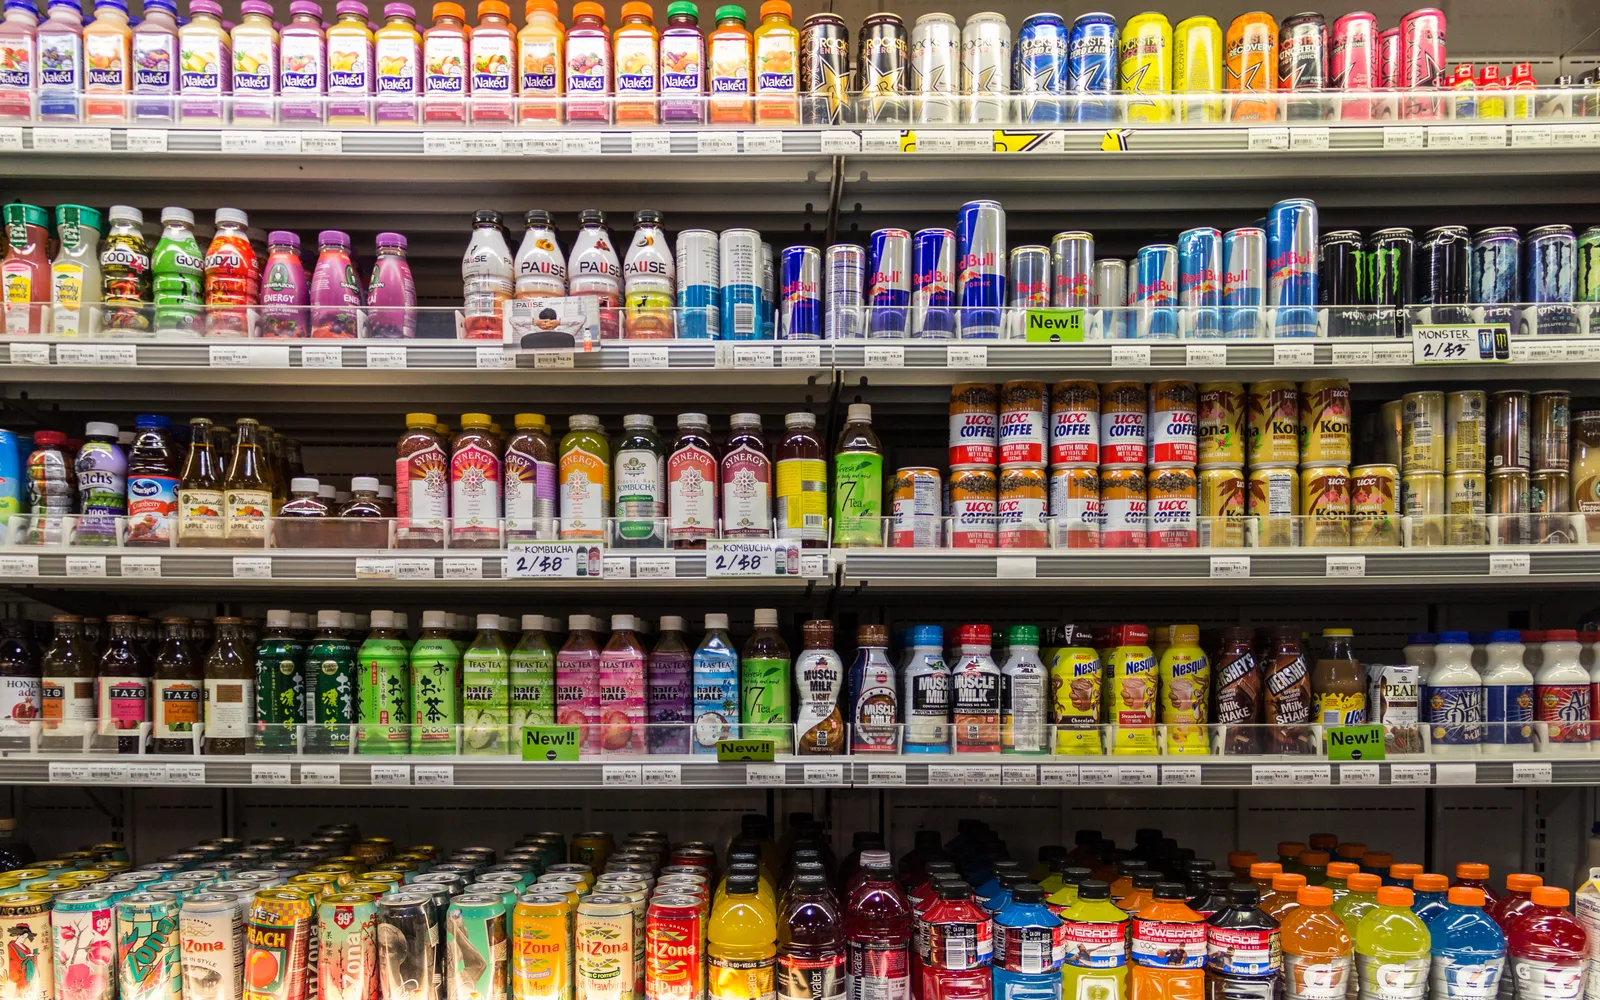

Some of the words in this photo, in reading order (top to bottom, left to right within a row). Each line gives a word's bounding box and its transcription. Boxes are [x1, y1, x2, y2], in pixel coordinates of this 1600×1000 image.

[0, 73, 28, 84] Naked
[42, 71, 72, 84] Naked
[90, 72, 120, 84] Naked
[137, 72, 167, 84] Naked
[183, 75, 216, 87] Naked
[236, 75, 268, 88] Naked
[282, 75, 315, 87] Naked
[331, 74, 363, 86] Naked
[428, 77, 460, 89] Naked
[475, 76, 507, 88] Naked
[523, 75, 554, 87] Naked
[570, 77, 602, 89] Naked
[620, 77, 653, 89] Naked
[664, 76, 697, 88] Naked
[761, 75, 793, 87] Naked
[379, 78, 411, 90] Naked
[714, 79, 746, 92] Naked
[464, 256, 487, 264] PAUSE
[969, 253, 993, 266] Bull
[1288, 252, 1313, 264] Bull
[521, 262, 564, 278] PAUSE
[580, 262, 620, 278] PAUSE
[625, 261, 665, 274] PAUSE
[878, 271, 899, 283] Bull
[914, 272, 933, 285] Red
[1057, 274, 1078, 285] Red
[1182, 271, 1203, 284] Red
[1225, 270, 1248, 284] Bull
[796, 281, 816, 293] Bull
[1016, 282, 1038, 293] Red
[1139, 281, 1156, 294] Red
[264, 294, 294, 302] ENERGY
[1030, 315, 1079, 329] New!!
[1418, 330, 1470, 339] MONSTER
[1423, 343, 1466, 357] 2/$3
[1333, 390, 1348, 398] UCC
[966, 415, 992, 425] UCC
[1002, 413, 1029, 423] UCC
[1058, 413, 1087, 424] UCC
[1114, 414, 1142, 424] UCC
[961, 426, 995, 438] COFFEE
[1000, 424, 1032, 437] COFFEE
[1055, 424, 1090, 437] COFFEE
[1110, 425, 1144, 437] COFFEE
[454, 452, 494, 467] SYNERGY
[561, 455, 599, 470] SYNERGY
[672, 452, 711, 467] SYNERGY
[726, 453, 765, 469] SYNERGY
[81, 472, 112, 485] elch's
[1357, 478, 1376, 486] UCC
[617, 484, 656, 492] KOMBUCHA
[133, 501, 160, 509] Cranberry
[849, 499, 862, 508] Tea
[966, 502, 993, 512] UCC
[1158, 500, 1188, 510] UCC
[1154, 512, 1190, 523] COFFEE
[525, 546, 573, 554] KOMBUCHA
[723, 544, 772, 552] KOMBUCHA
[517, 556, 562, 572] 2/$8
[716, 555, 761, 571] 2/$8
[488, 661, 501, 669] TEA
[535, 661, 548, 669] TEA
[579, 661, 591, 669] TEA
[622, 661, 633, 669] TEA
[1172, 655, 1208, 678] Nesquik
[804, 669, 837, 681] MUSCLE
[810, 681, 832, 692] MILK
[955, 675, 994, 689] MUSCLE
[18, 688, 36, 697] ade
[113, 689, 145, 697] TAZO
[165, 691, 198, 699] TAZO
[467, 693, 493, 701] HALF
[812, 693, 830, 701] LIGHT
[959, 689, 988, 702] MILK
[743, 686, 765, 716] 17
[1220, 701, 1240, 713] Milk
[757, 704, 771, 713] Tea
[864, 704, 895, 715] MUSCLE
[1280, 701, 1303, 714] Milk
[870, 715, 891, 725] MILK
[1219, 707, 1250, 724] SHAKE
[1276, 706, 1309, 725] SHAKE
[526, 731, 574, 745] New!!
[1331, 730, 1379, 746] New!!
[721, 743, 769, 753] New!!
[96, 918, 110, 931] 99¢
[336, 913, 353, 925] 99¢
[1139, 926, 1204, 937] POWERADE
[576, 941, 629, 956] AriZona
[197, 957, 218, 967] STYLE
[662, 982, 693, 993] Punch
